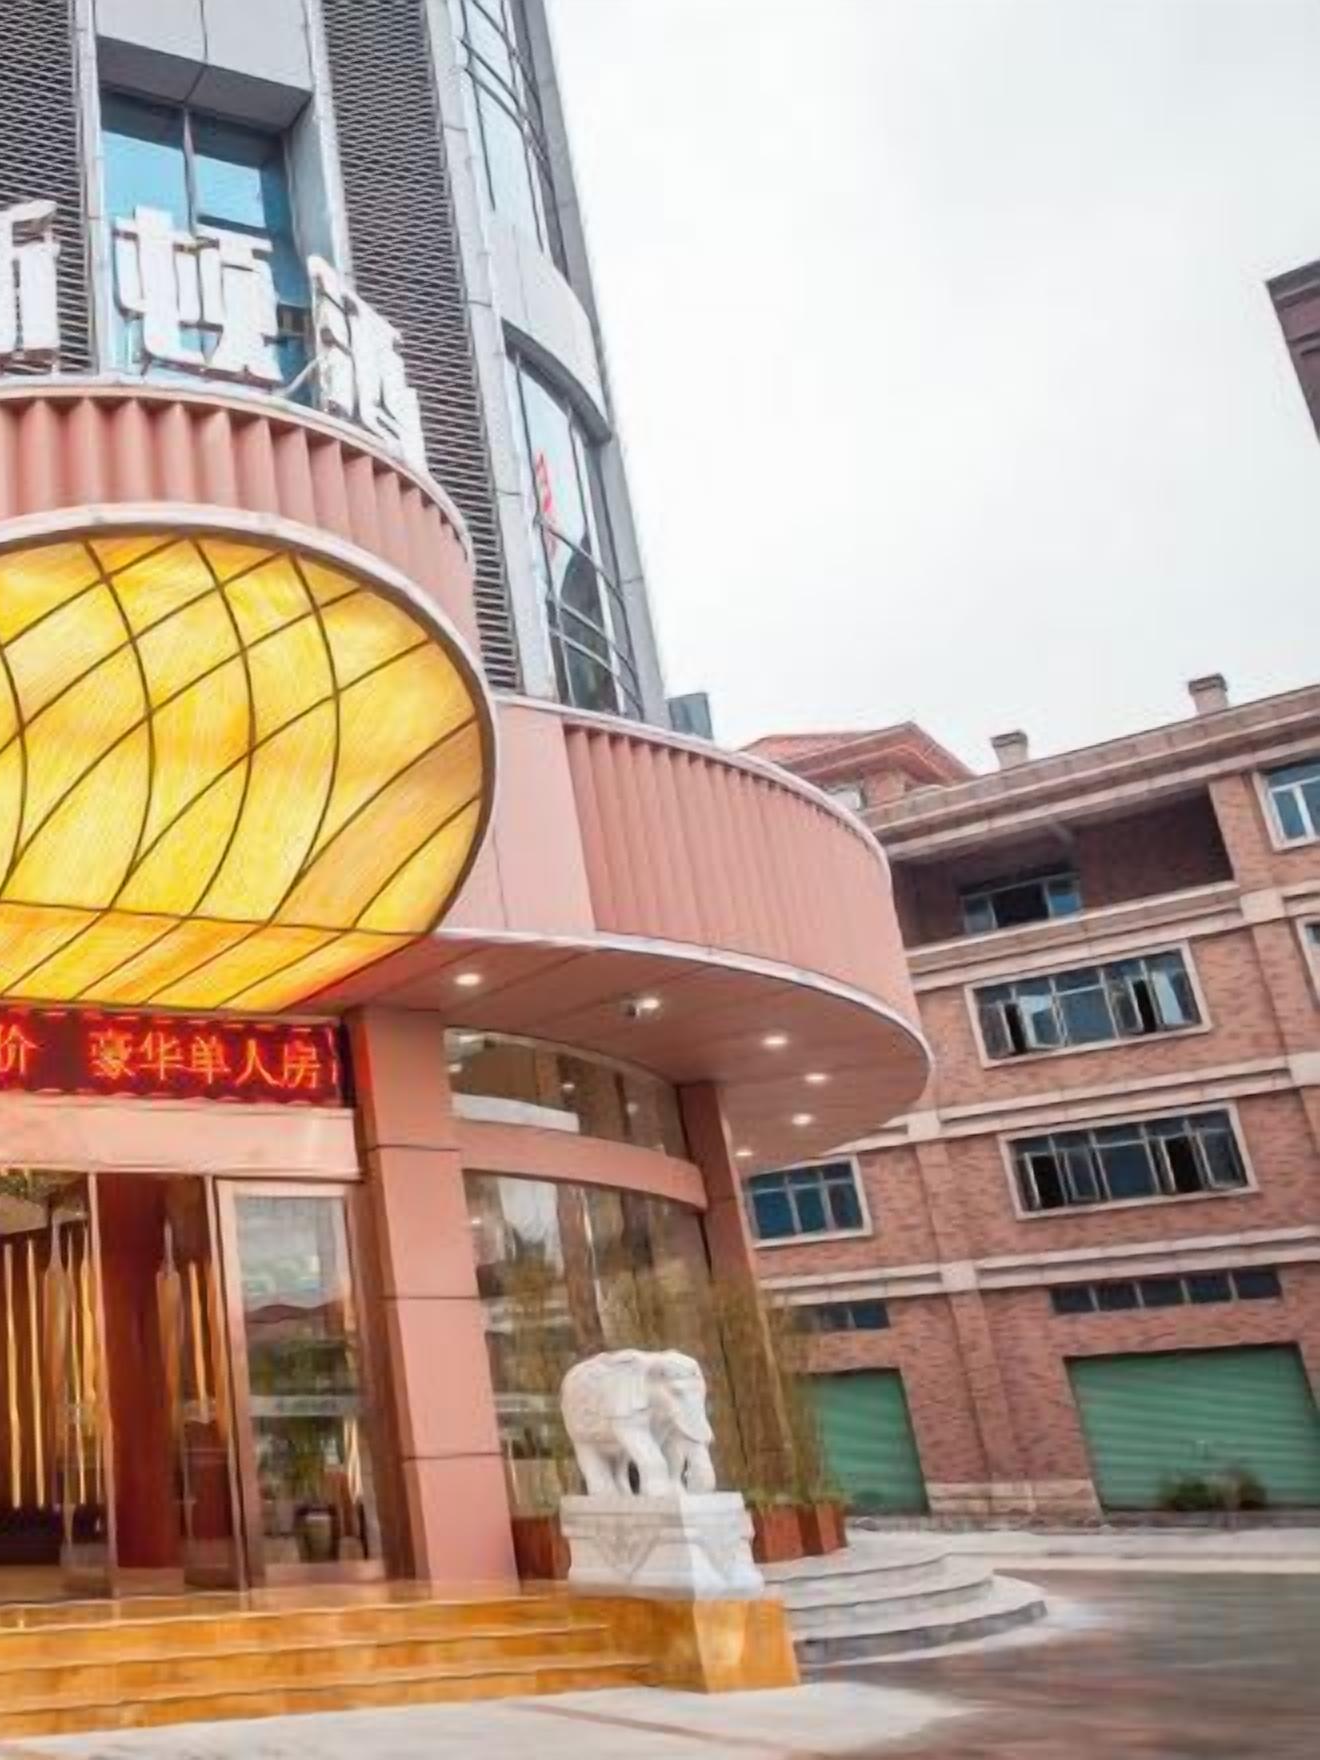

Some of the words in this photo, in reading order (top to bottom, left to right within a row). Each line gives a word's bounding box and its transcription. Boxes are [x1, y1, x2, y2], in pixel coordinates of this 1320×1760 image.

[88, 1027, 321, 1090] 豪华单人房
